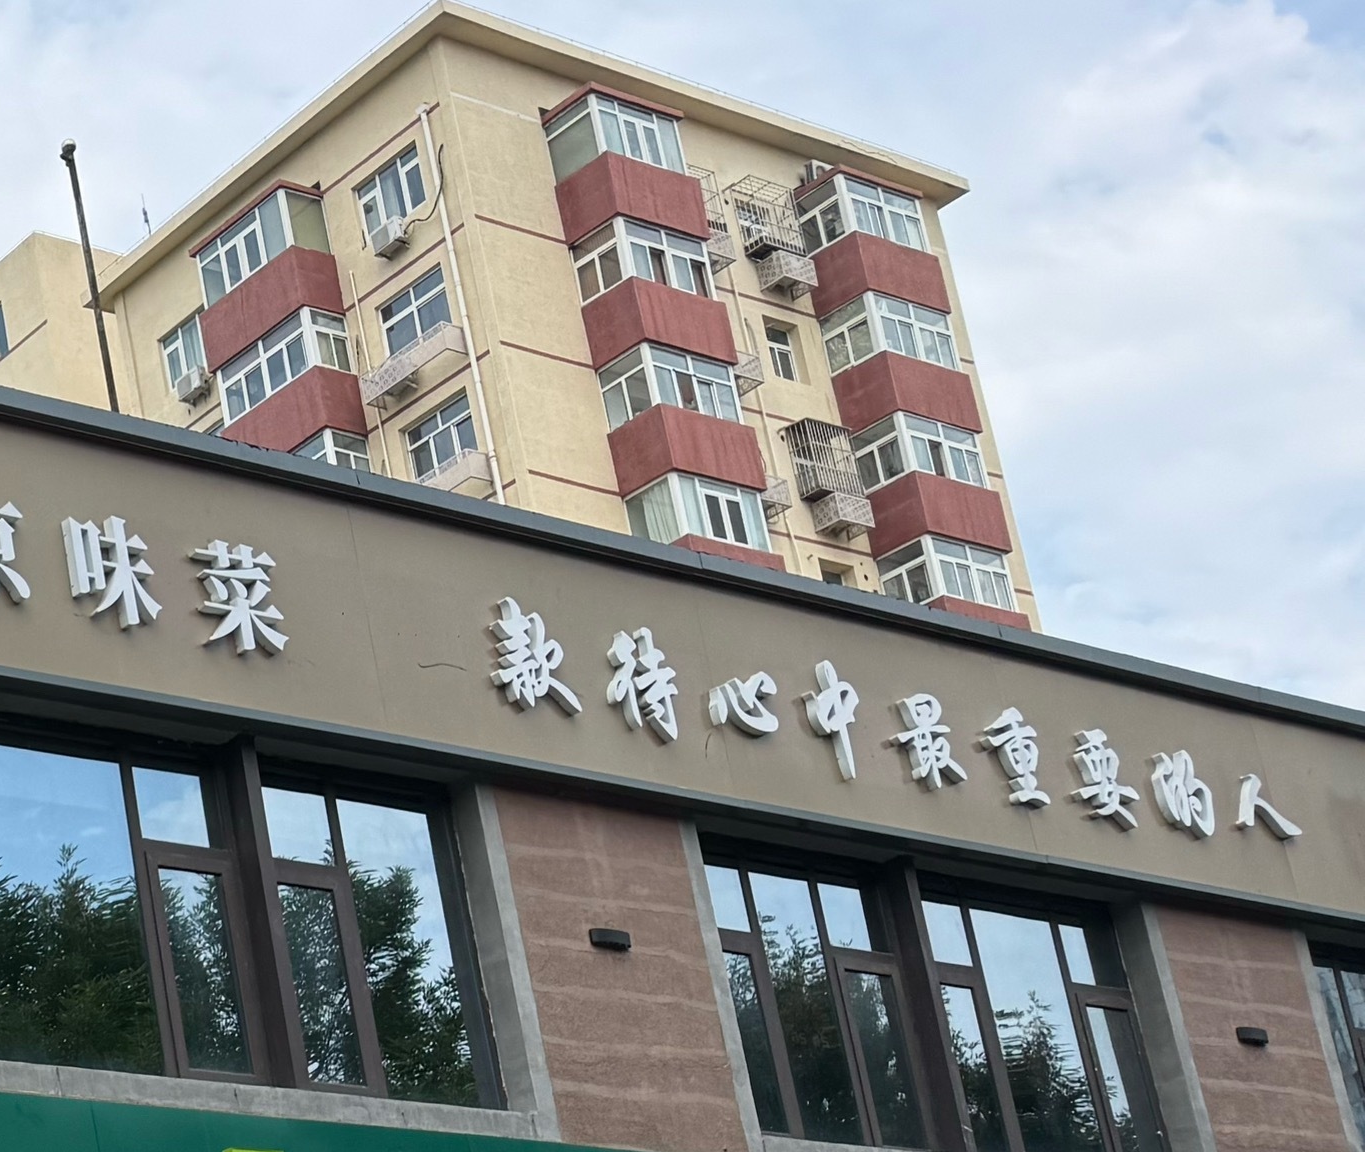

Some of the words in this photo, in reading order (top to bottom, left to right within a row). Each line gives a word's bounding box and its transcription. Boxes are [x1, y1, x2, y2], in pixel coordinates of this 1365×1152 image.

[488, 597, 1301, 839] 款待心中最重要的人
